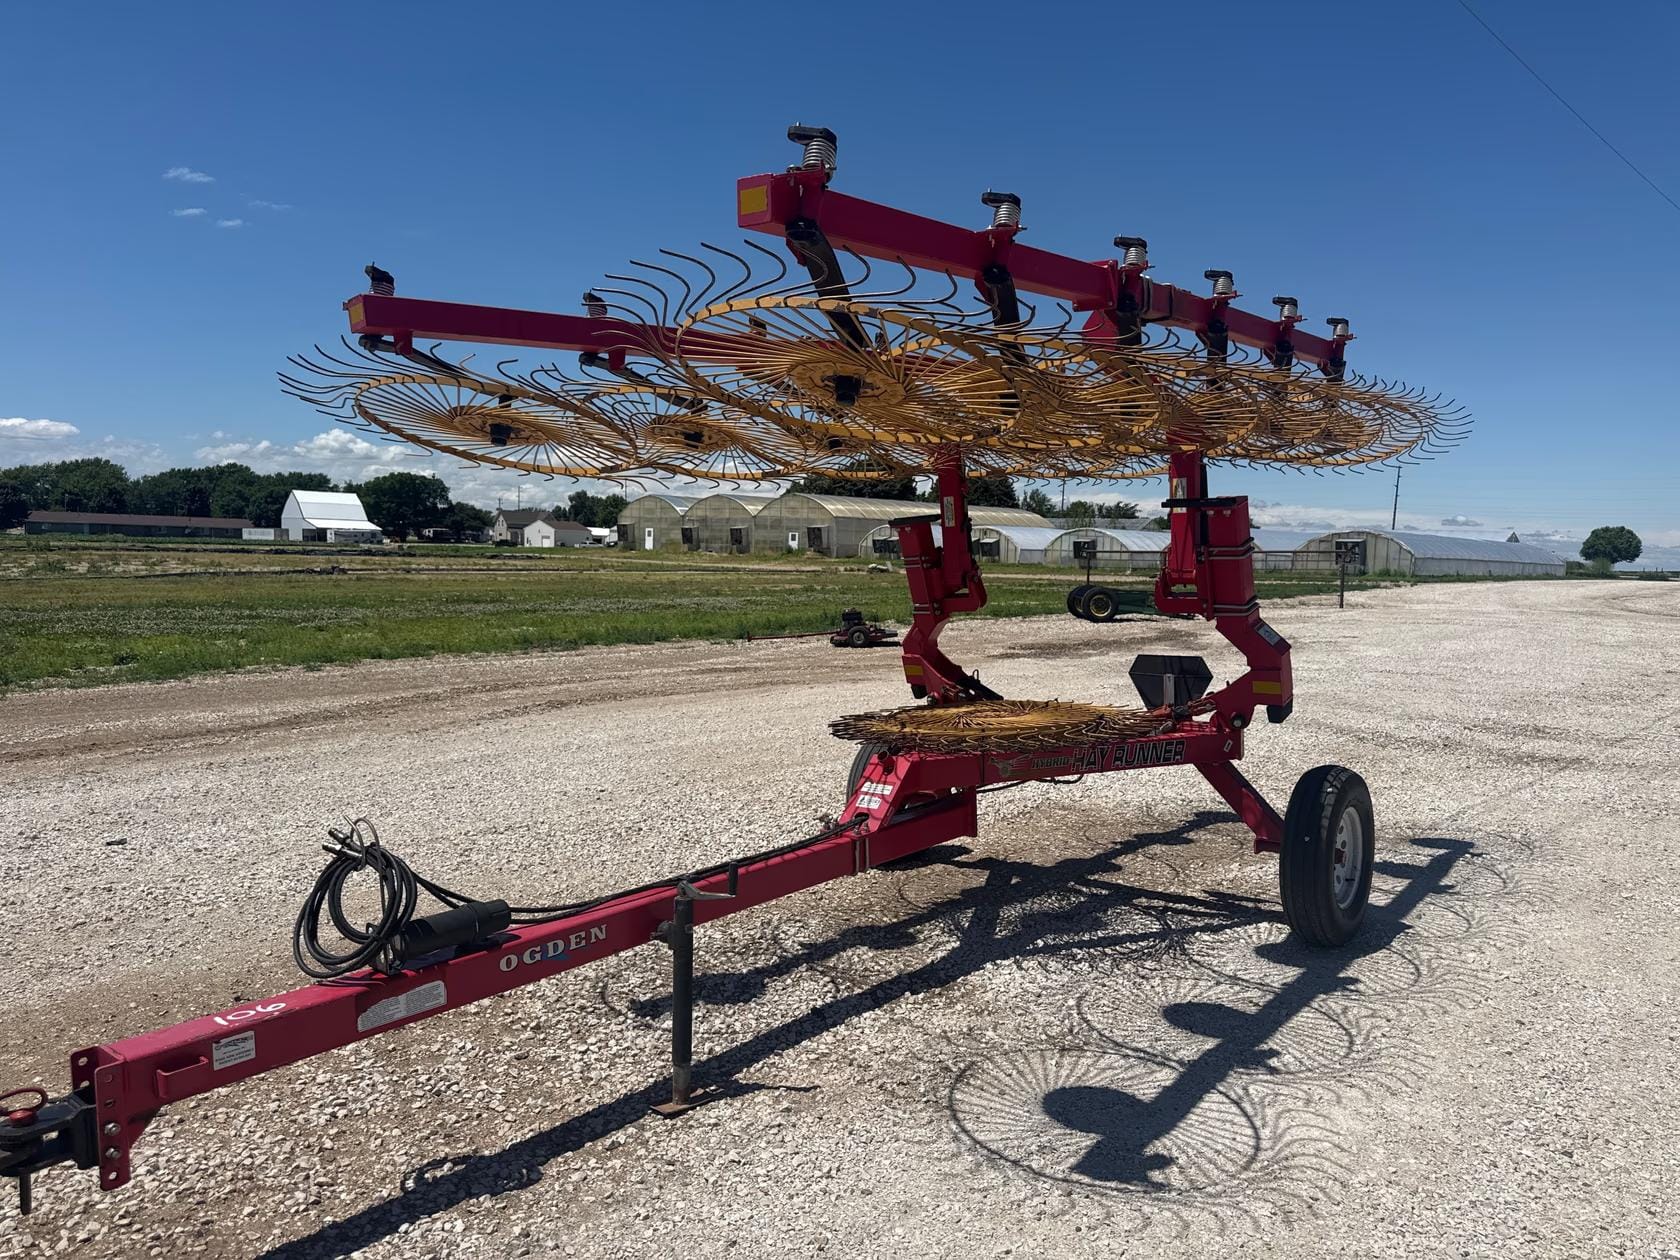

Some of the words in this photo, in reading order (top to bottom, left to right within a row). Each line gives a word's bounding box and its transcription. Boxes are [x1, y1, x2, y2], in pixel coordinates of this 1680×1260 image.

[1071, 746, 1111, 772] HAY
[1112, 740, 1186, 768] RUNNER
[499, 924, 608, 972] OGDEN
[213, 1003, 287, 1025] 106
